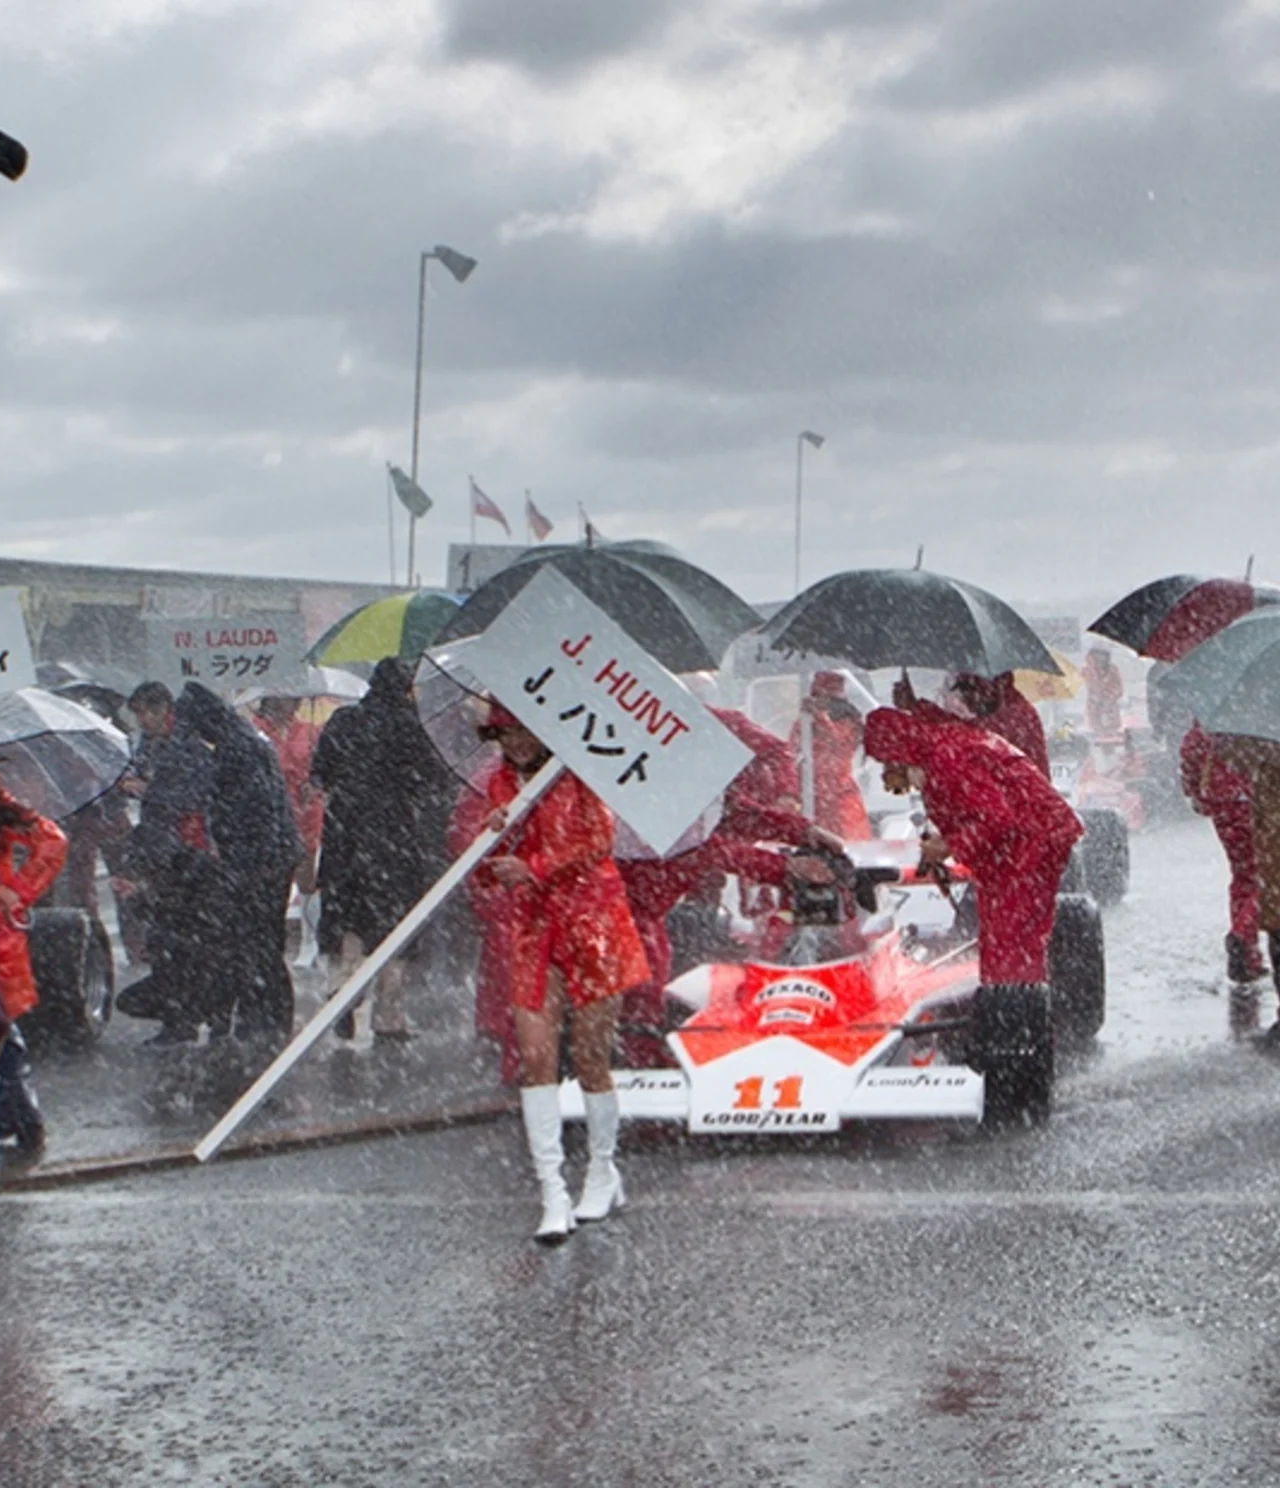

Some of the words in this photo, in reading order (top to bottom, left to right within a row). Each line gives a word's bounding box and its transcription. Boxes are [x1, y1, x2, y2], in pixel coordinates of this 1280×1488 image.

[175, 631, 198, 649] N.
[206, 628, 278, 649] LAUDA
[211, 653, 274, 677] ラウダ
[561, 634, 593, 666] J.
[594, 658, 690, 746] HUNT
[523, 667, 554, 705] J.
[559, 703, 649, 785] ハント
[756, 982, 832, 1004] TEXACO
[732, 1075, 804, 1109] 11
